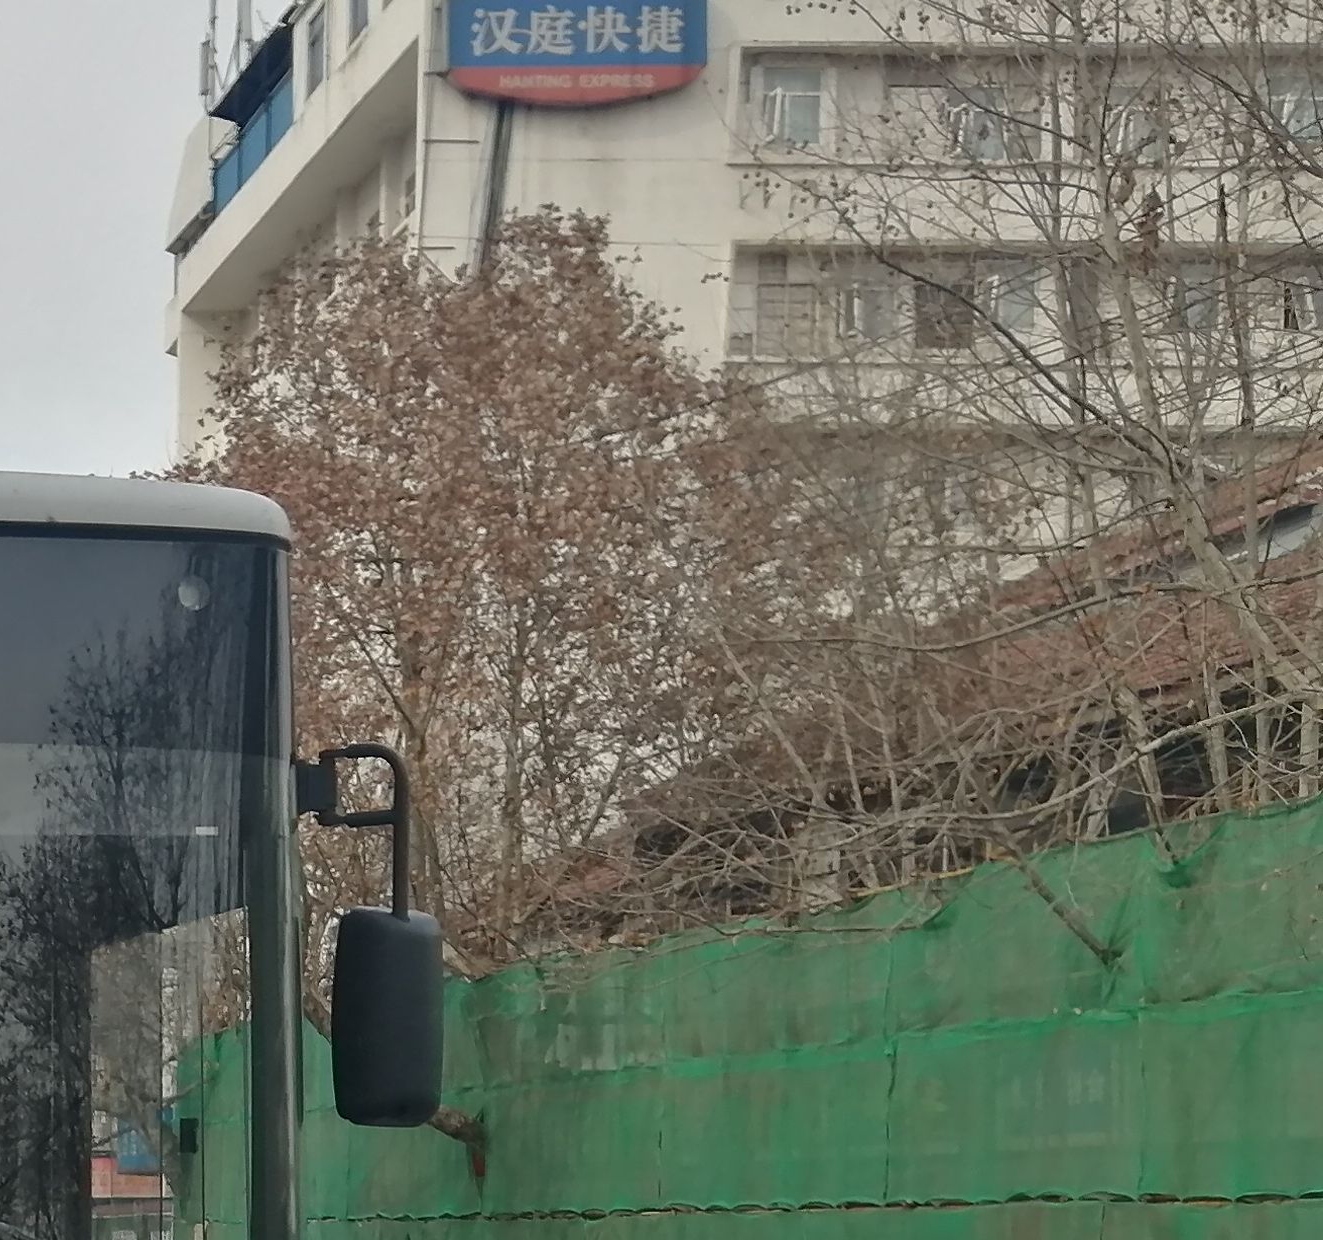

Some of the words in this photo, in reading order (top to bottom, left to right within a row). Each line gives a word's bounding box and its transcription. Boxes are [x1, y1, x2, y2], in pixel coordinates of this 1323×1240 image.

[470, 5, 685, 56] 汉庭快捷
[499, 73, 573, 88] HANTING
[578, 73, 657, 89] EXPRESS
